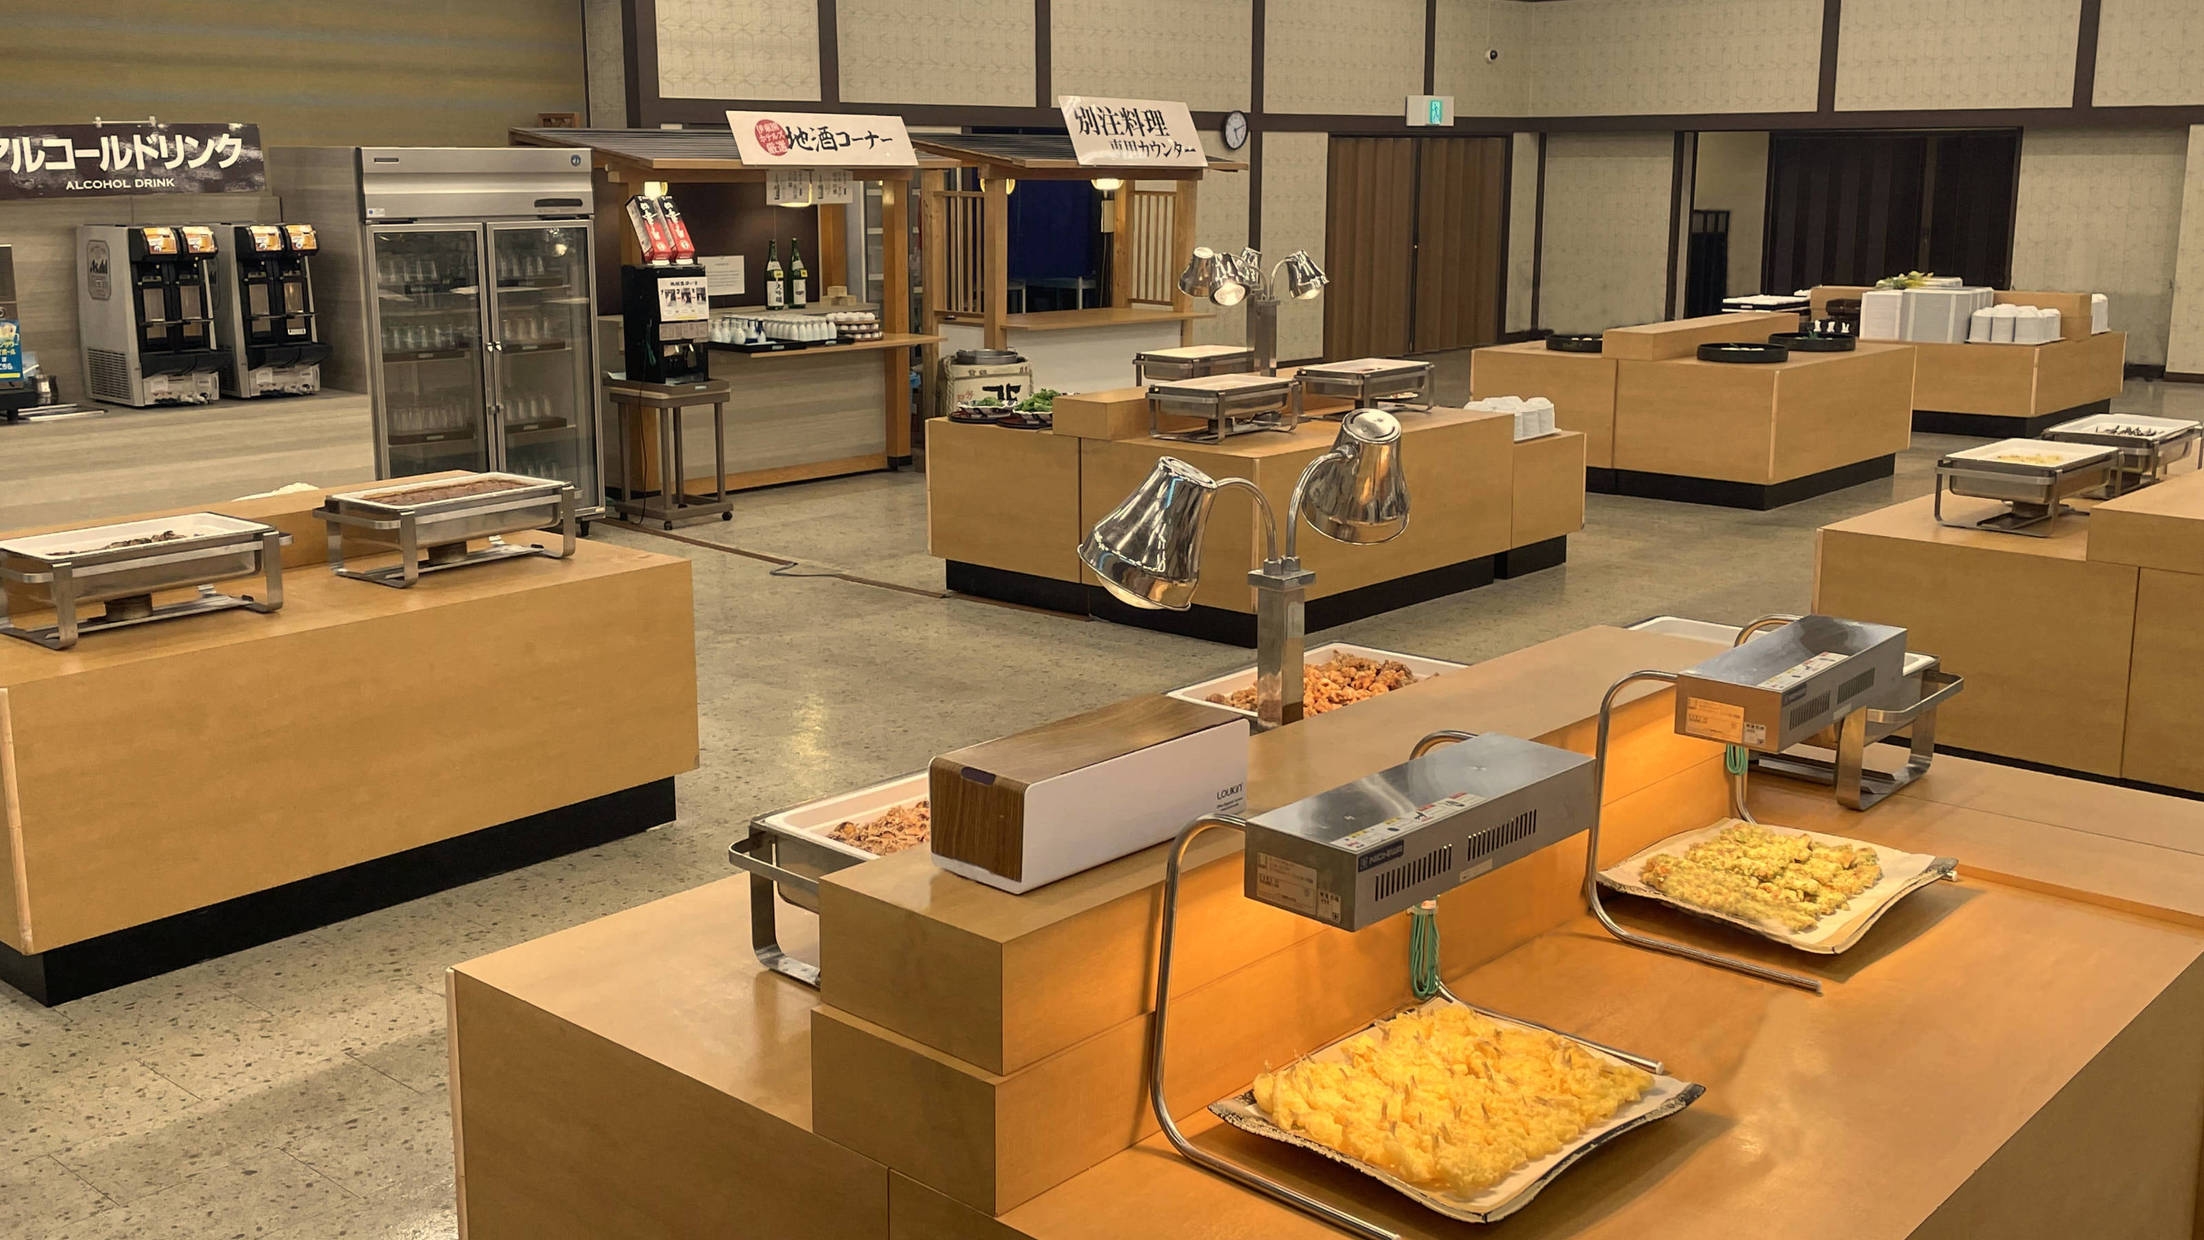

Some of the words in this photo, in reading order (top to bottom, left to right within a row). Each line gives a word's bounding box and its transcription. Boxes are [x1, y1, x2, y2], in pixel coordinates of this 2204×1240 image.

[1074, 105, 1171, 137] 別注料理
[785, 125, 894, 152] 地酒コーナー
[66, 178, 132, 191] ALCOHOL
[134, 177, 176, 189] DRINK
